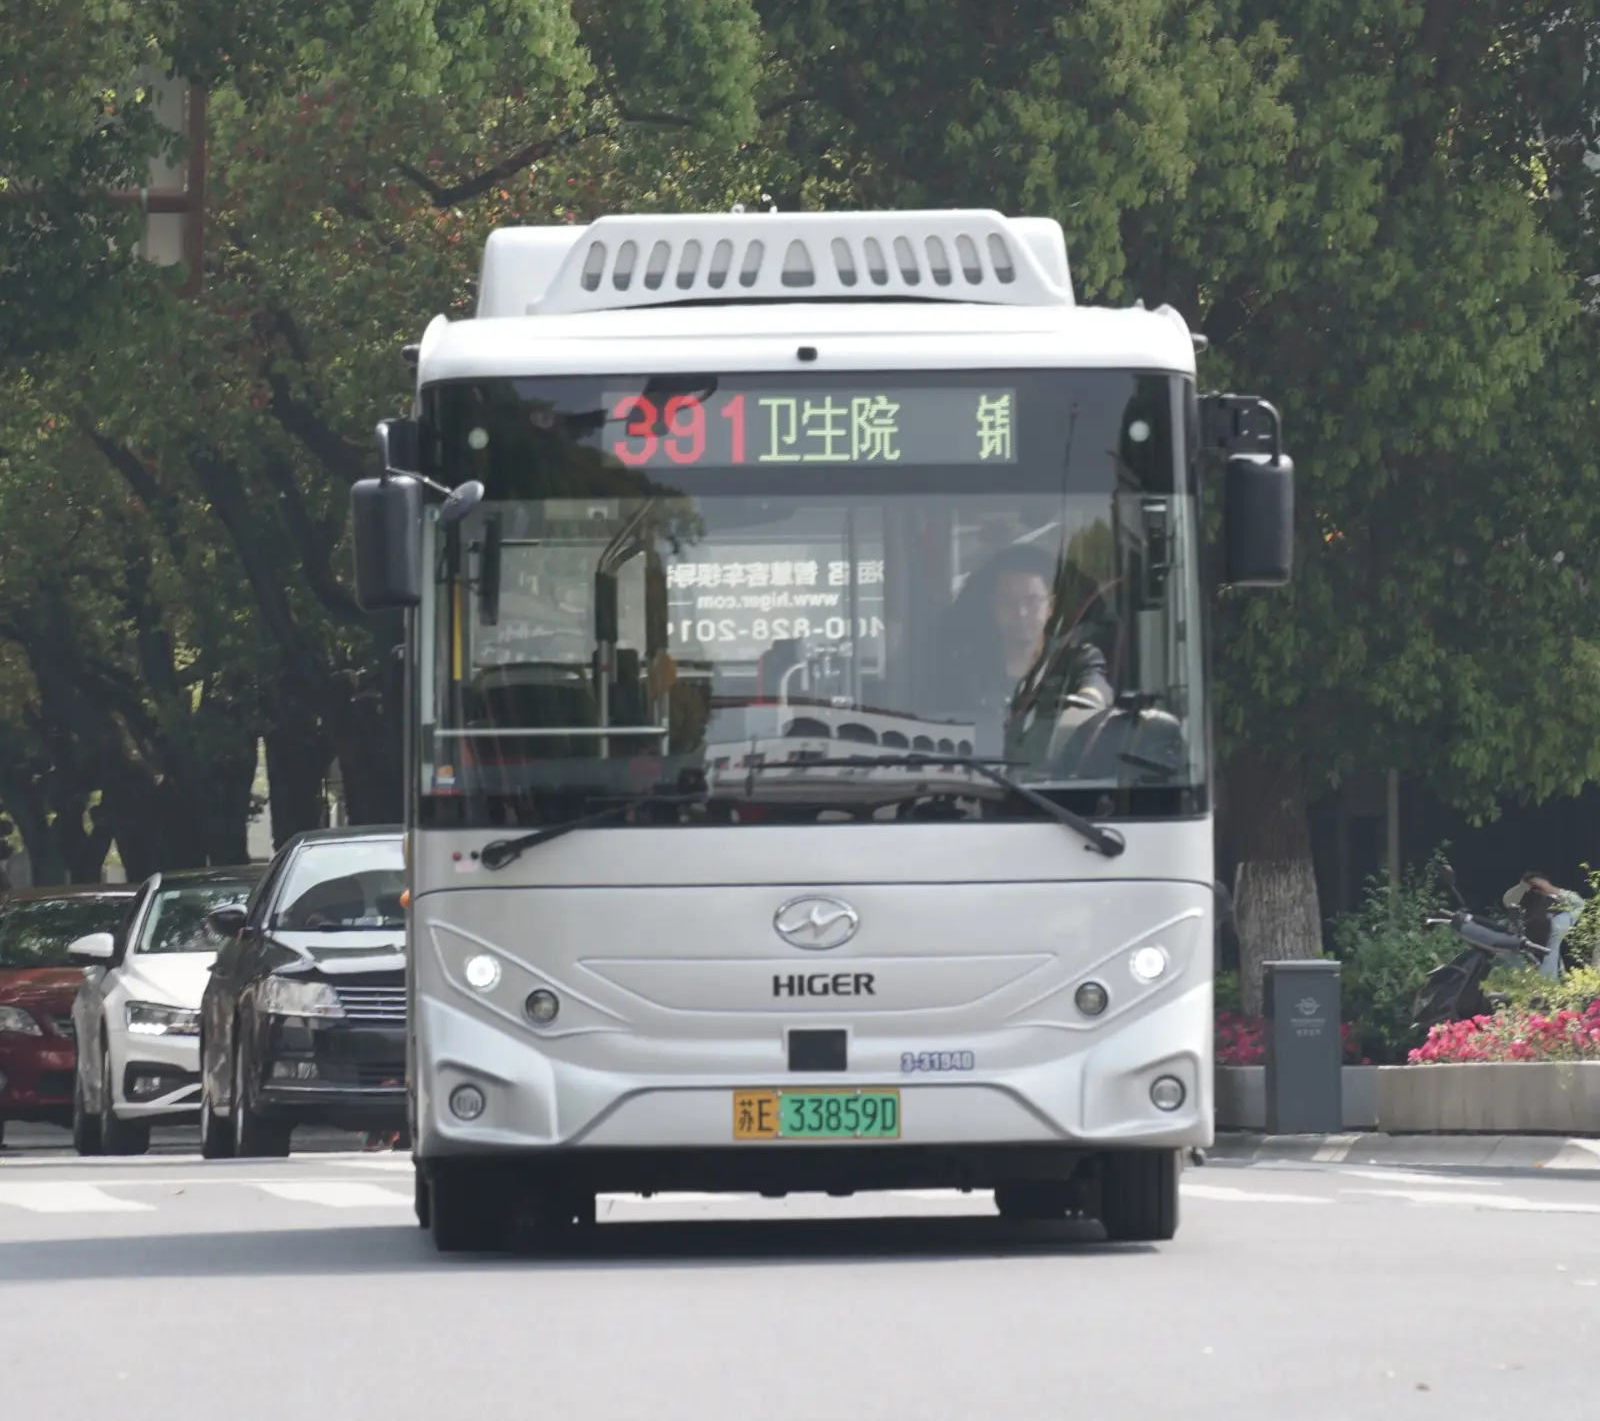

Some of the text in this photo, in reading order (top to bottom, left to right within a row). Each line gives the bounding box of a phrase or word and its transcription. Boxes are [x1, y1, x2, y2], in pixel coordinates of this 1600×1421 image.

[613, 394, 746, 465] 391
[758, 394, 900, 461] 卫生院
[773, 973, 876, 997] HIGER
